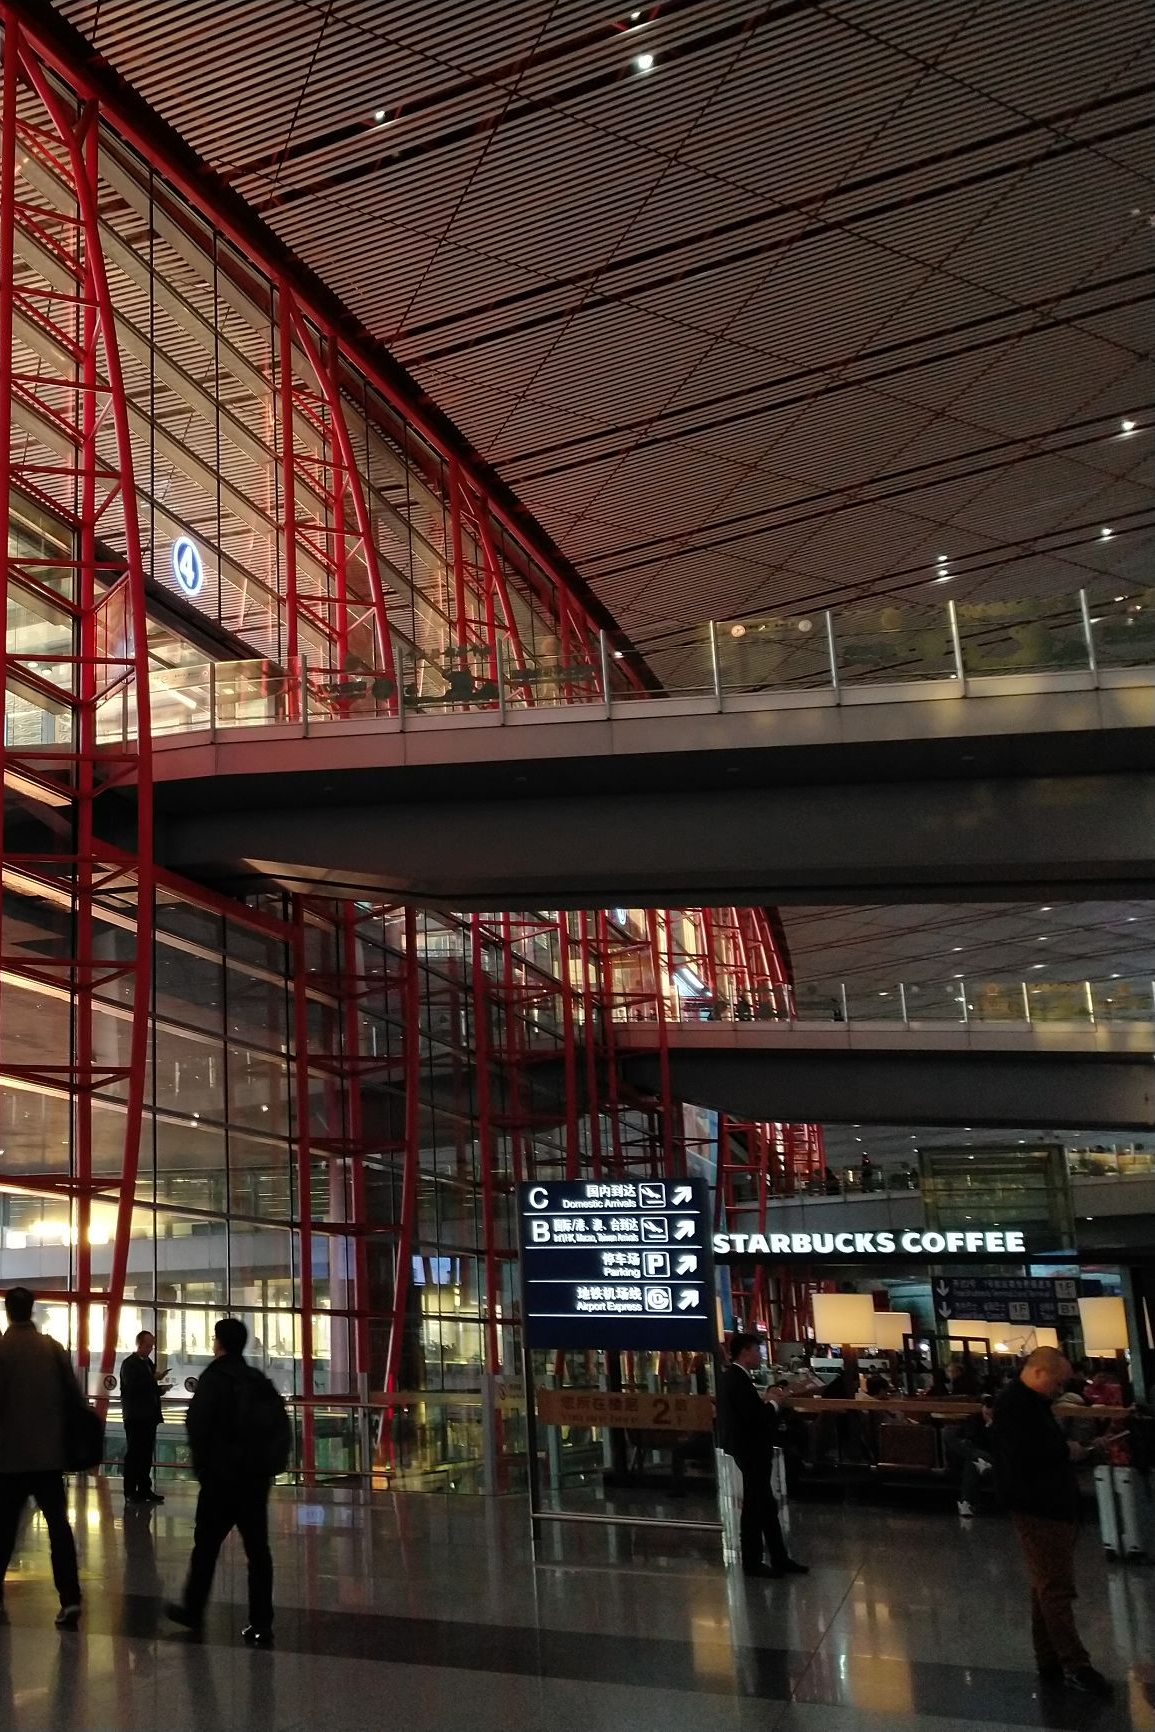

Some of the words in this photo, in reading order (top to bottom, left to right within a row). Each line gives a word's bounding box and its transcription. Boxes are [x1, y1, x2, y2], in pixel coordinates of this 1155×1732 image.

[529, 1187, 549, 1209] C
[586, 1184, 636, 1198] 国内到达
[563, 1199, 603, 1208] Domestic
[604, 1199, 636, 1208] Arrivals
[532, 1220, 551, 1242] B
[713, 1232, 895, 1254] STARBUCKS
[900, 1231, 1025, 1254] COFFEE
[602, 1252, 640, 1265] 停车场
[604, 1267, 640, 1278] Parking
[577, 1286, 642, 1300] 地铁机场线
[577, 1301, 606, 1312] Airport
[607, 1301, 642, 1312] Express
[652, 1398, 671, 1425] 2
